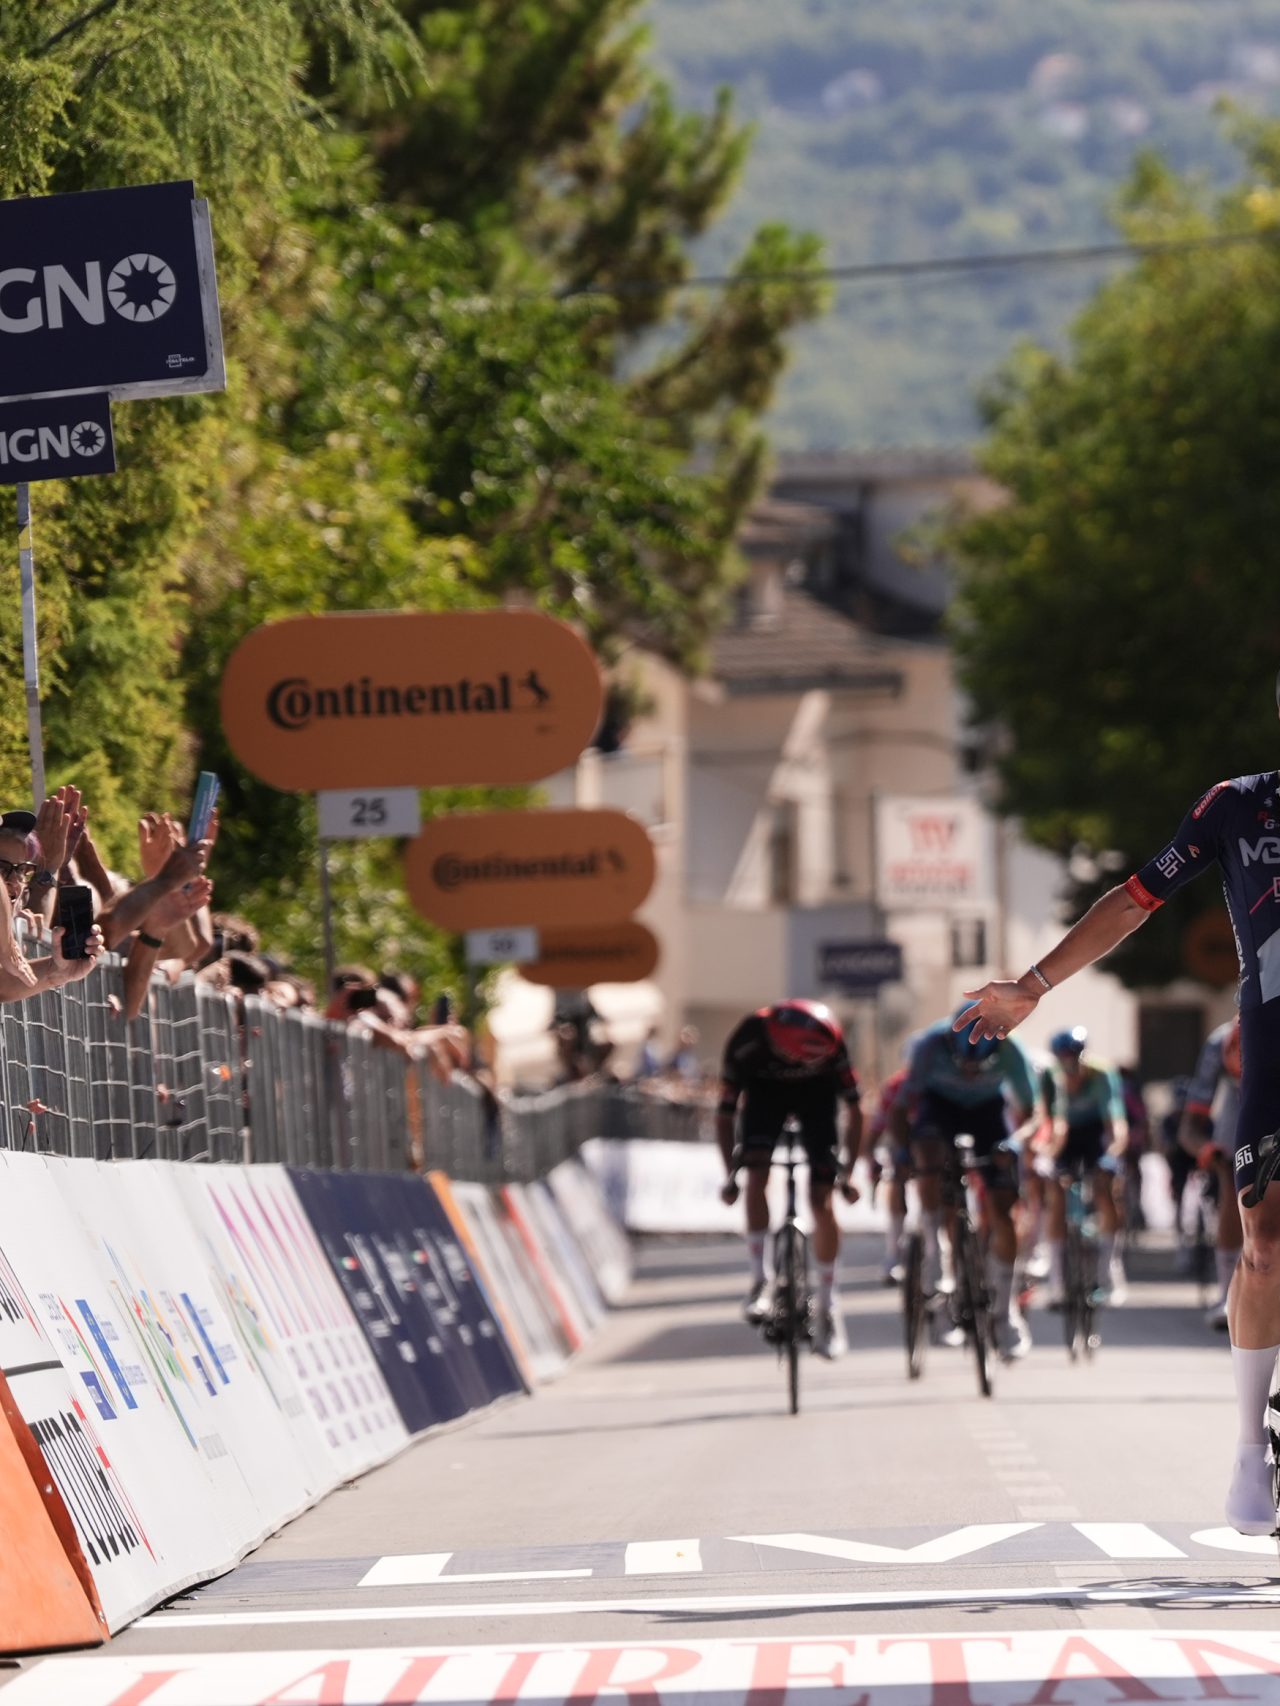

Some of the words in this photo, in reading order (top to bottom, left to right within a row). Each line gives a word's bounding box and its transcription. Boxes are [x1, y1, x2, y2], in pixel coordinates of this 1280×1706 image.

[266, 671, 512, 730] Continental
[350, 798, 388, 827] 25
[432, 851, 599, 892] Continental
